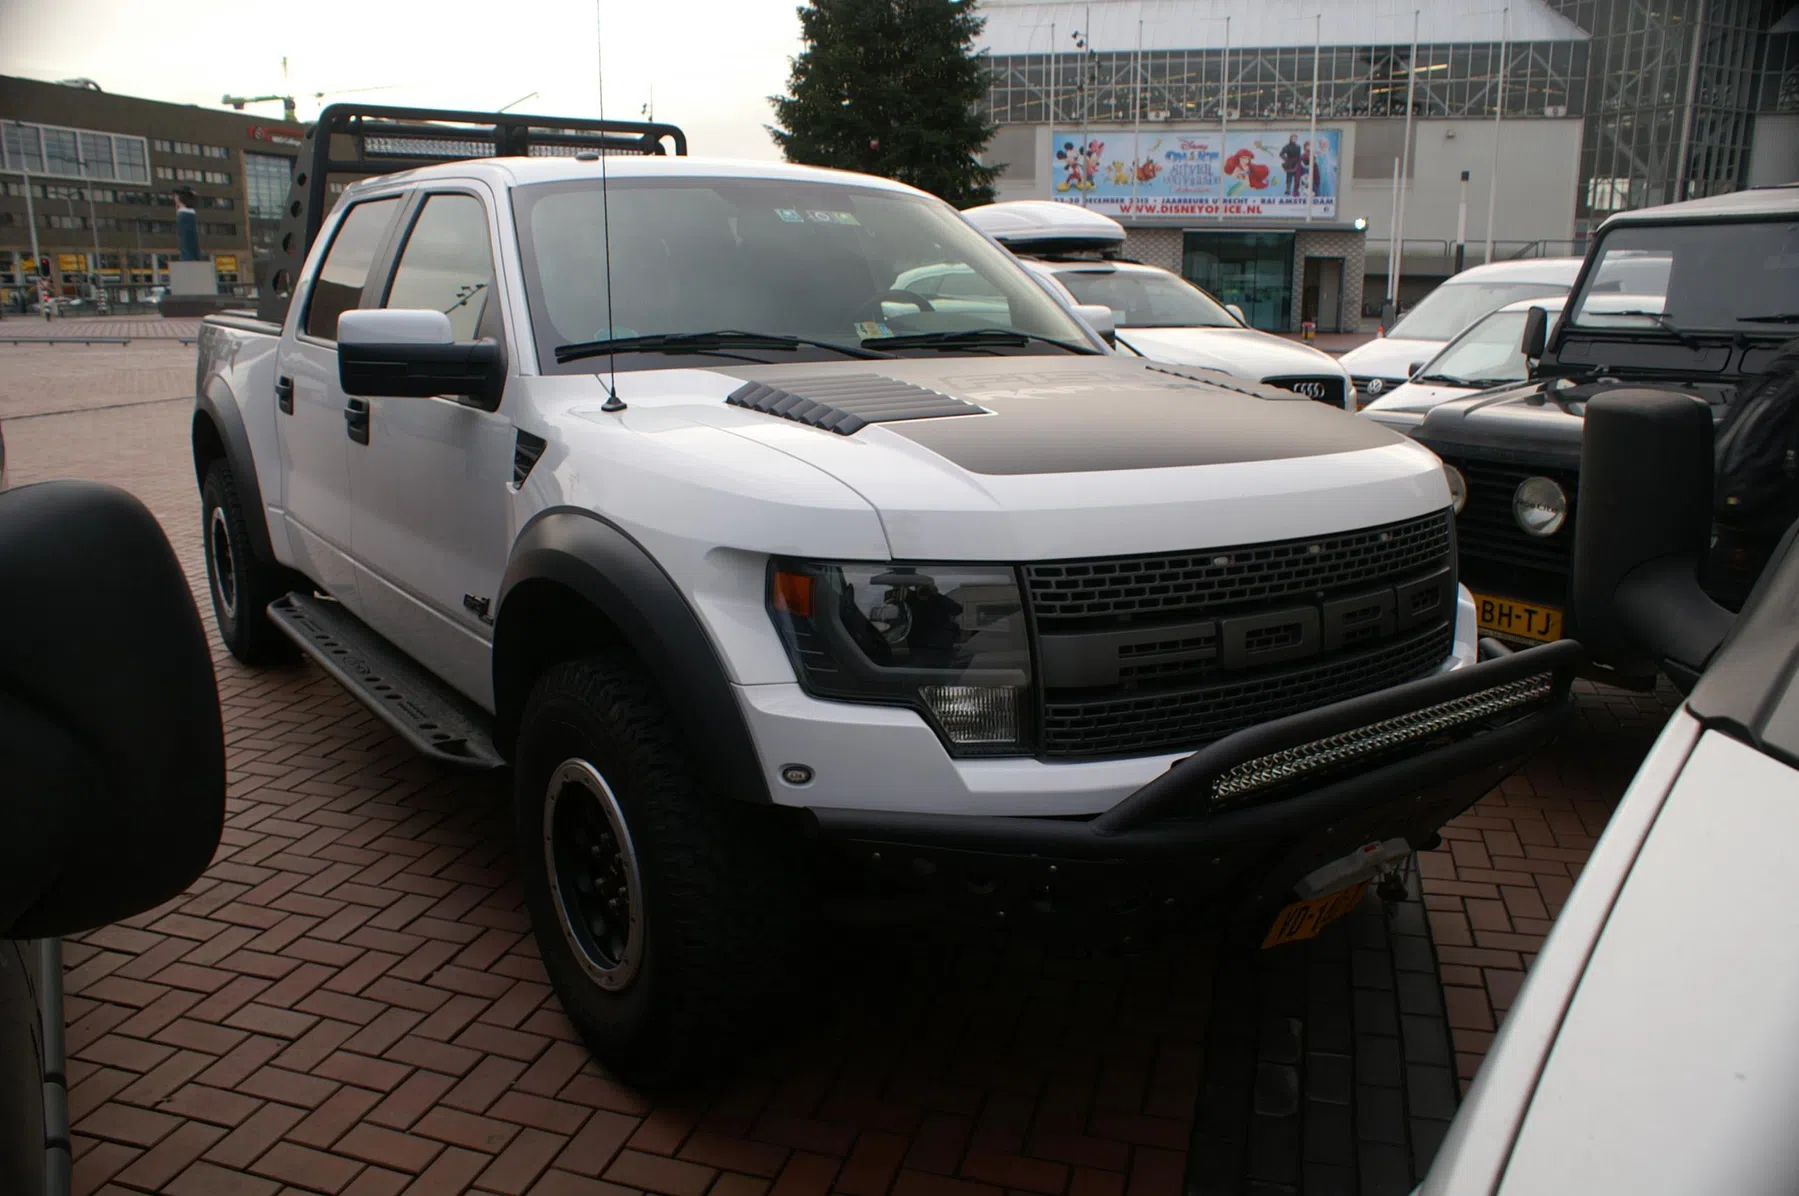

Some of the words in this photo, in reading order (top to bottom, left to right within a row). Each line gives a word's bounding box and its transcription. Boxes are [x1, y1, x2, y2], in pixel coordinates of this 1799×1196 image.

[1180, 140, 1208, 151] Disney
[1161, 197, 1209, 205] JAARBEURS
[1212, 197, 1248, 205] URECHT
[1040, 566, 1451, 689] FORD
